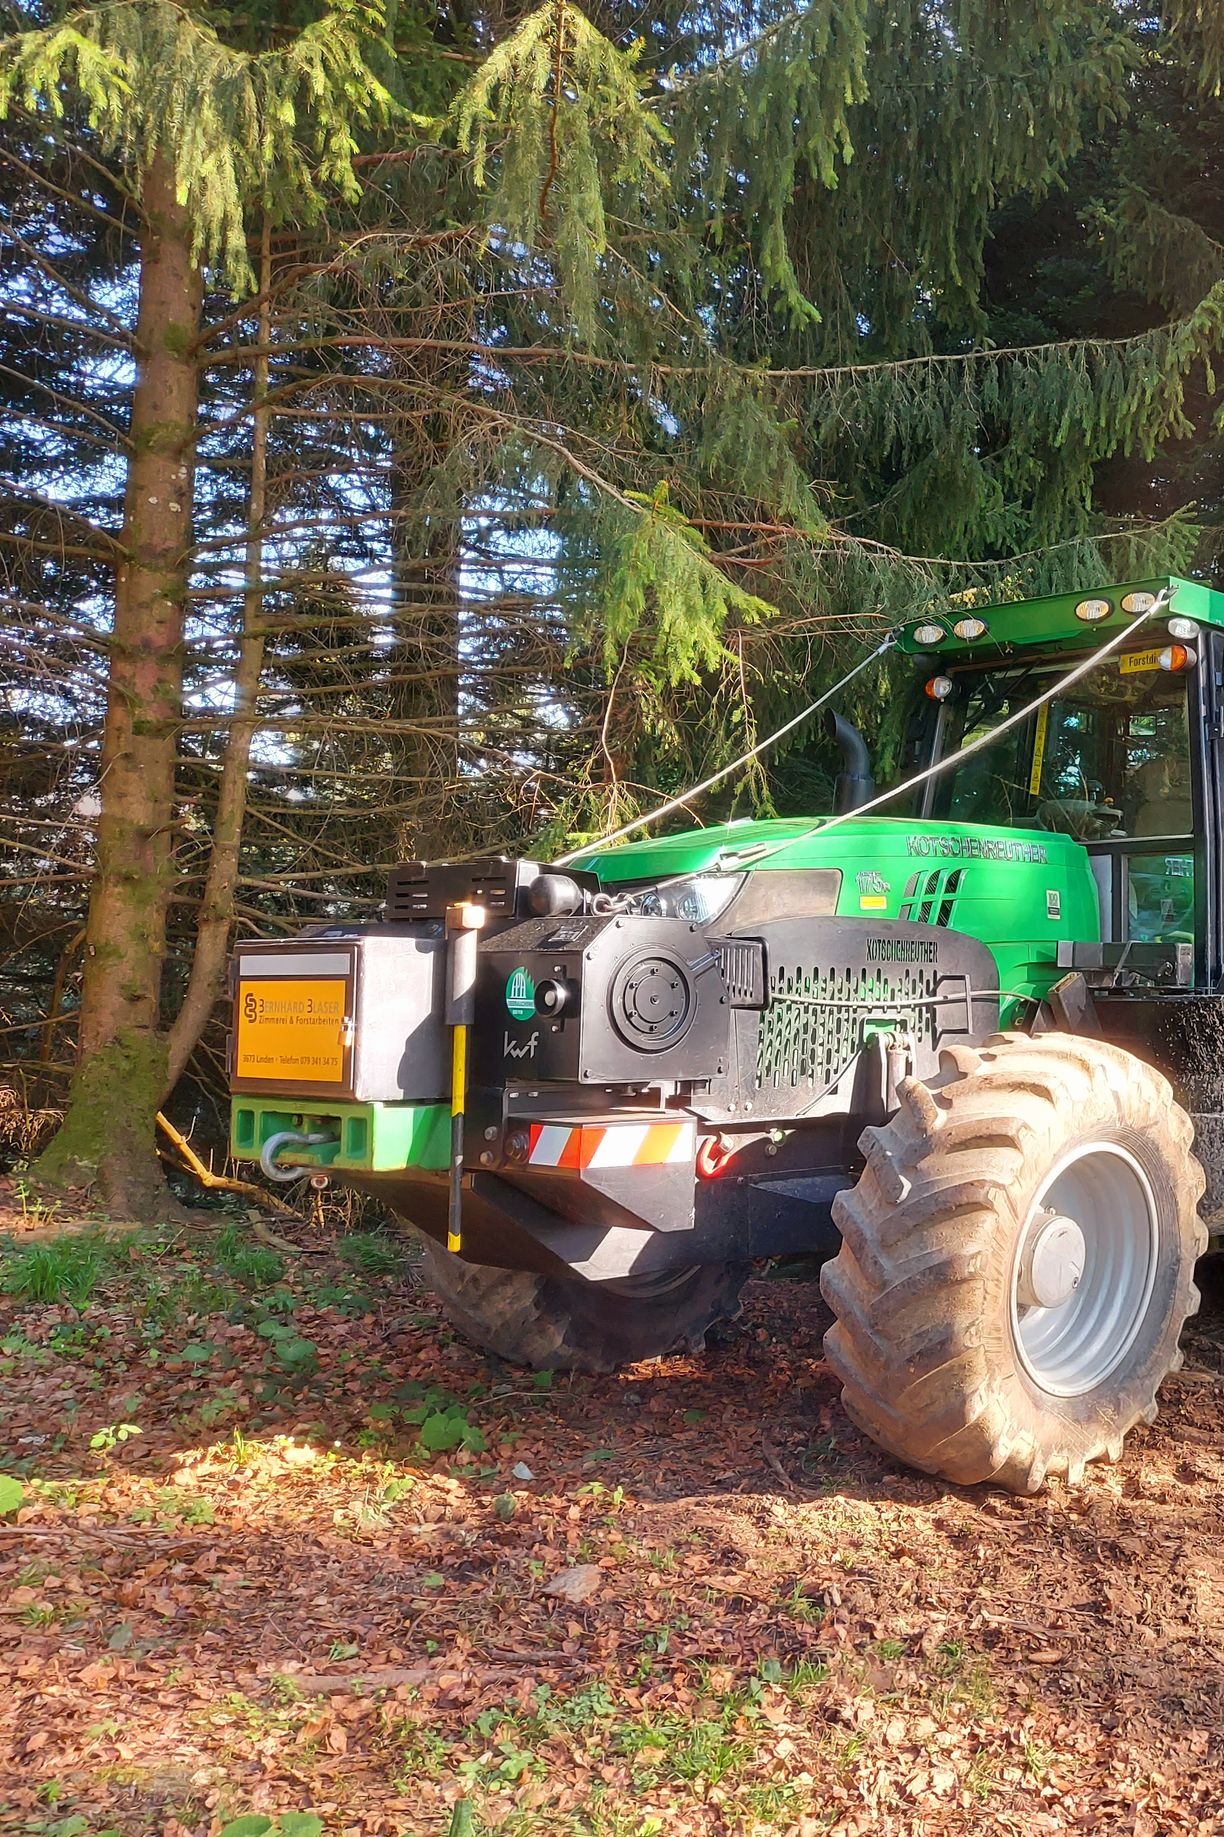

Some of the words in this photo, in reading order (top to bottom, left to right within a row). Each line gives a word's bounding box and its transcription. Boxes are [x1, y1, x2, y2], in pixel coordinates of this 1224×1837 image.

[1129, 653, 1160, 667] Forstdi
[905, 835, 1049, 864] KOTSCHENREUTHER
[866, 938, 938, 963] KOTSCHENREUTHER
[259, 1015, 288, 1025] Zimmerei
[296, 1015, 340, 1026] Forstarbeiten
[256, 1055, 275, 1064] Linden
[280, 1055, 300, 1065] Telefon
